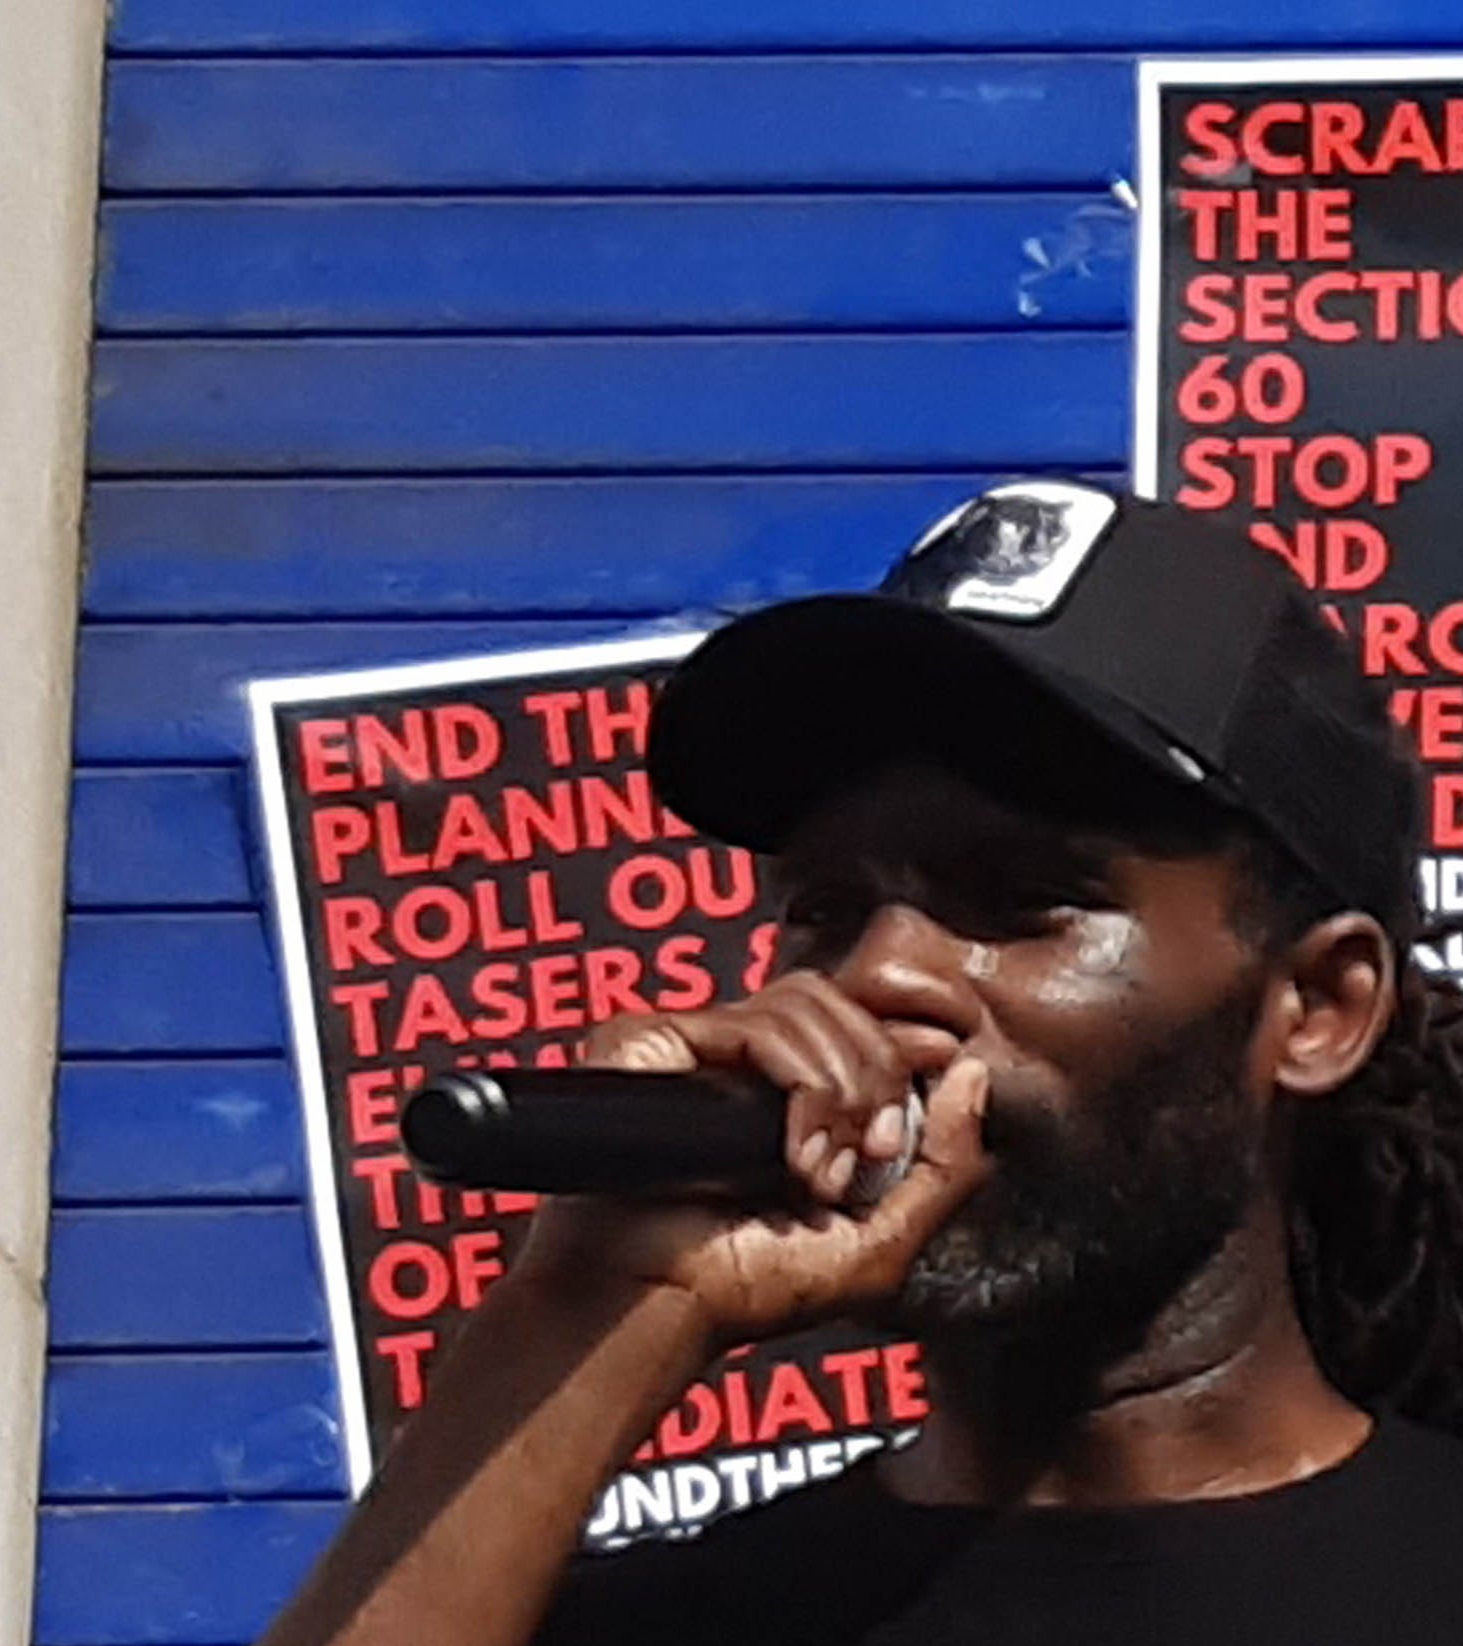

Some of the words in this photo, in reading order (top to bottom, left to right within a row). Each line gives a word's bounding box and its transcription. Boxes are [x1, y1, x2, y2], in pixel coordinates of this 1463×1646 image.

[1178, 186, 1353, 262] THE
[1175, 353, 1306, 425] 60
[1178, 434, 1433, 510] STOP
[1248, 519, 1390, 594] ND
[298, 704, 505, 795] END
[524, 682, 654, 768] TH
[310, 770, 700, 885] PLANN
[320, 870, 584, 973] ROLL
[607, 847, 758, 930] OU
[330, 930, 718, 1060] TASERS
[366, 1230, 505, 1320] OF
